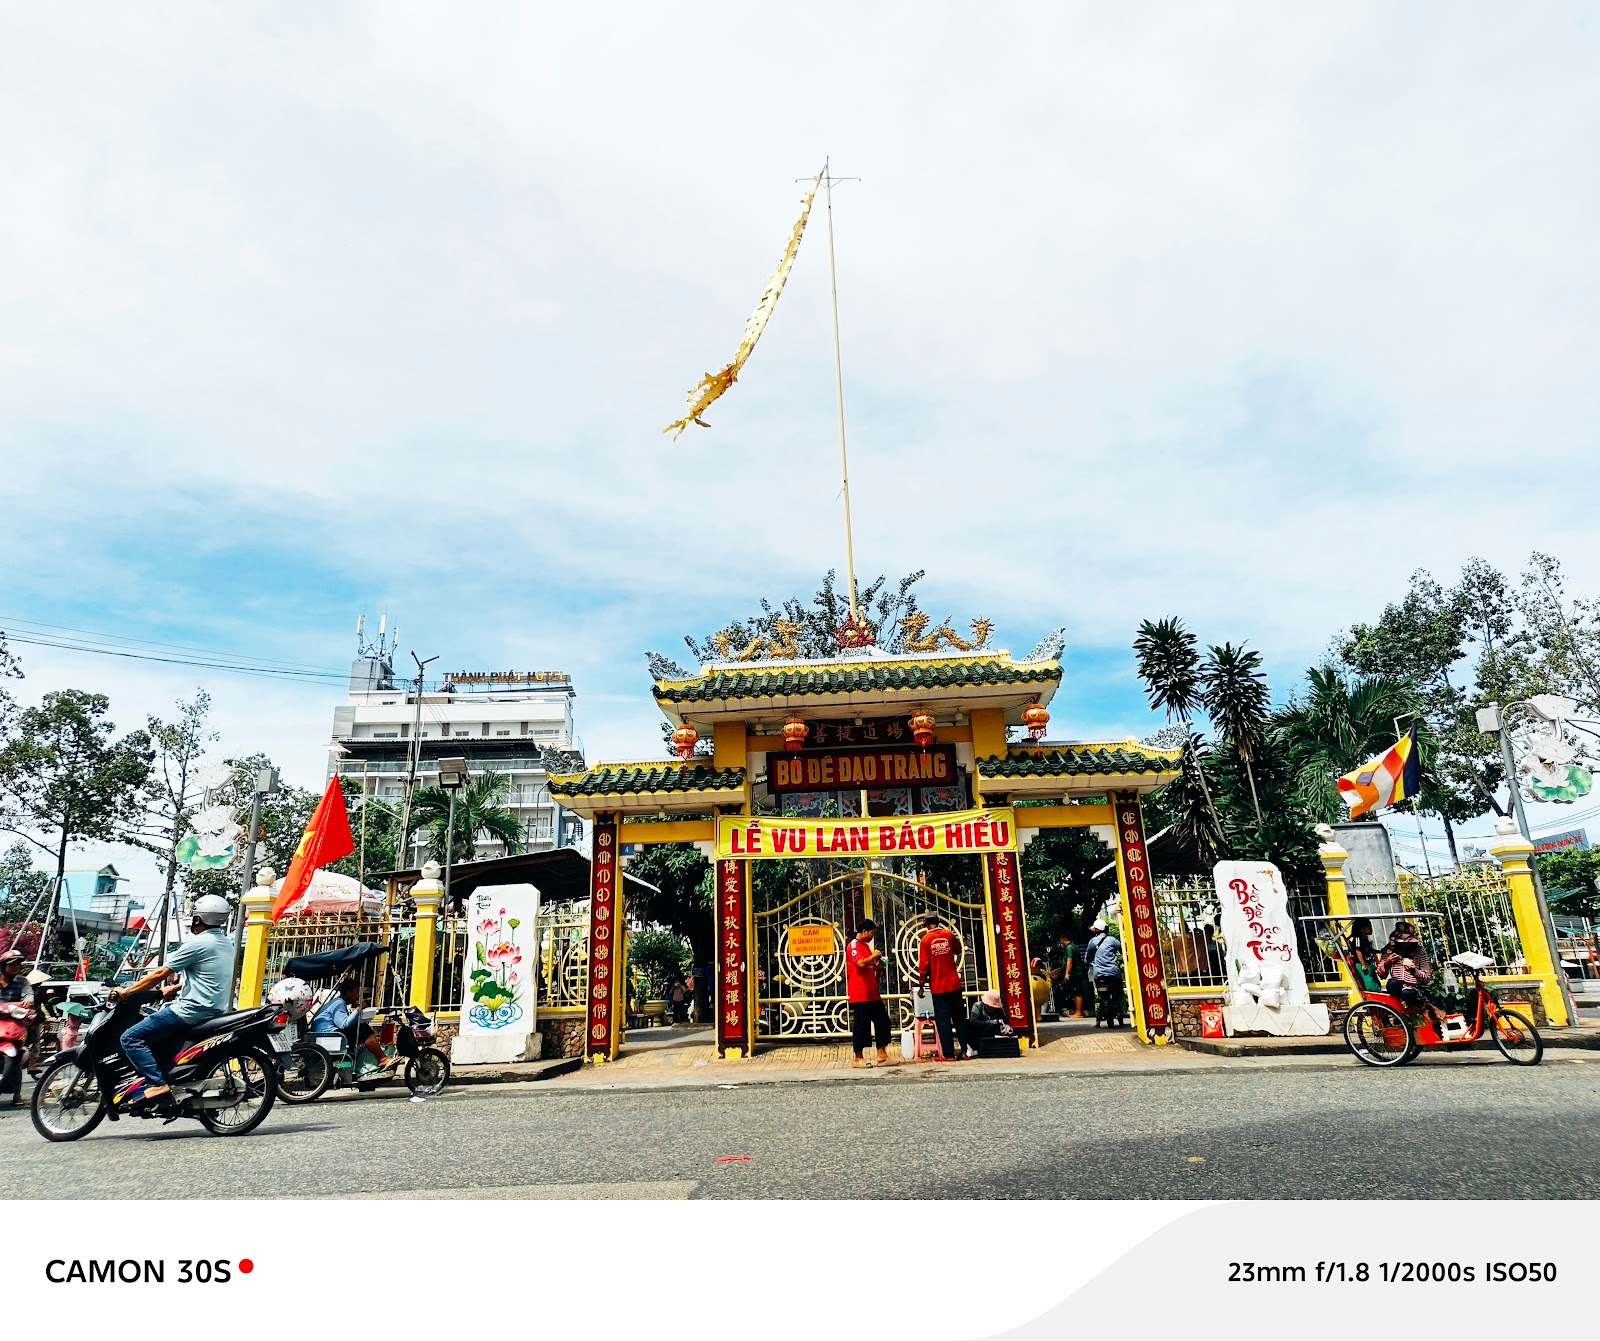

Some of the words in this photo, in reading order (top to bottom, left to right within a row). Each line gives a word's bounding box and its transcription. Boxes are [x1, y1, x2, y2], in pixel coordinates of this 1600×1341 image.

[443, 670, 485, 682] THÀNH
[491, 670, 523, 682] PHÁT
[527, 671, 566, 682] HOTEL
[813, 721, 903, 743] 菩提道場
[807, 754, 833, 784] ĐỀ
[839, 756, 876, 785] ĐẠO
[881, 751, 946, 780] TRÀNG
[731, 820, 762, 854] LỄ
[771, 828, 806, 853] VU
[816, 826, 870, 853] LAN
[879, 820, 935, 851] BÁO
[945, 813, 1009, 849] HIẾU
[1229, 878, 1260, 905] Bồ
[1243, 903, 1265, 921] Đề
[1249, 922, 1281, 939] Đạo
